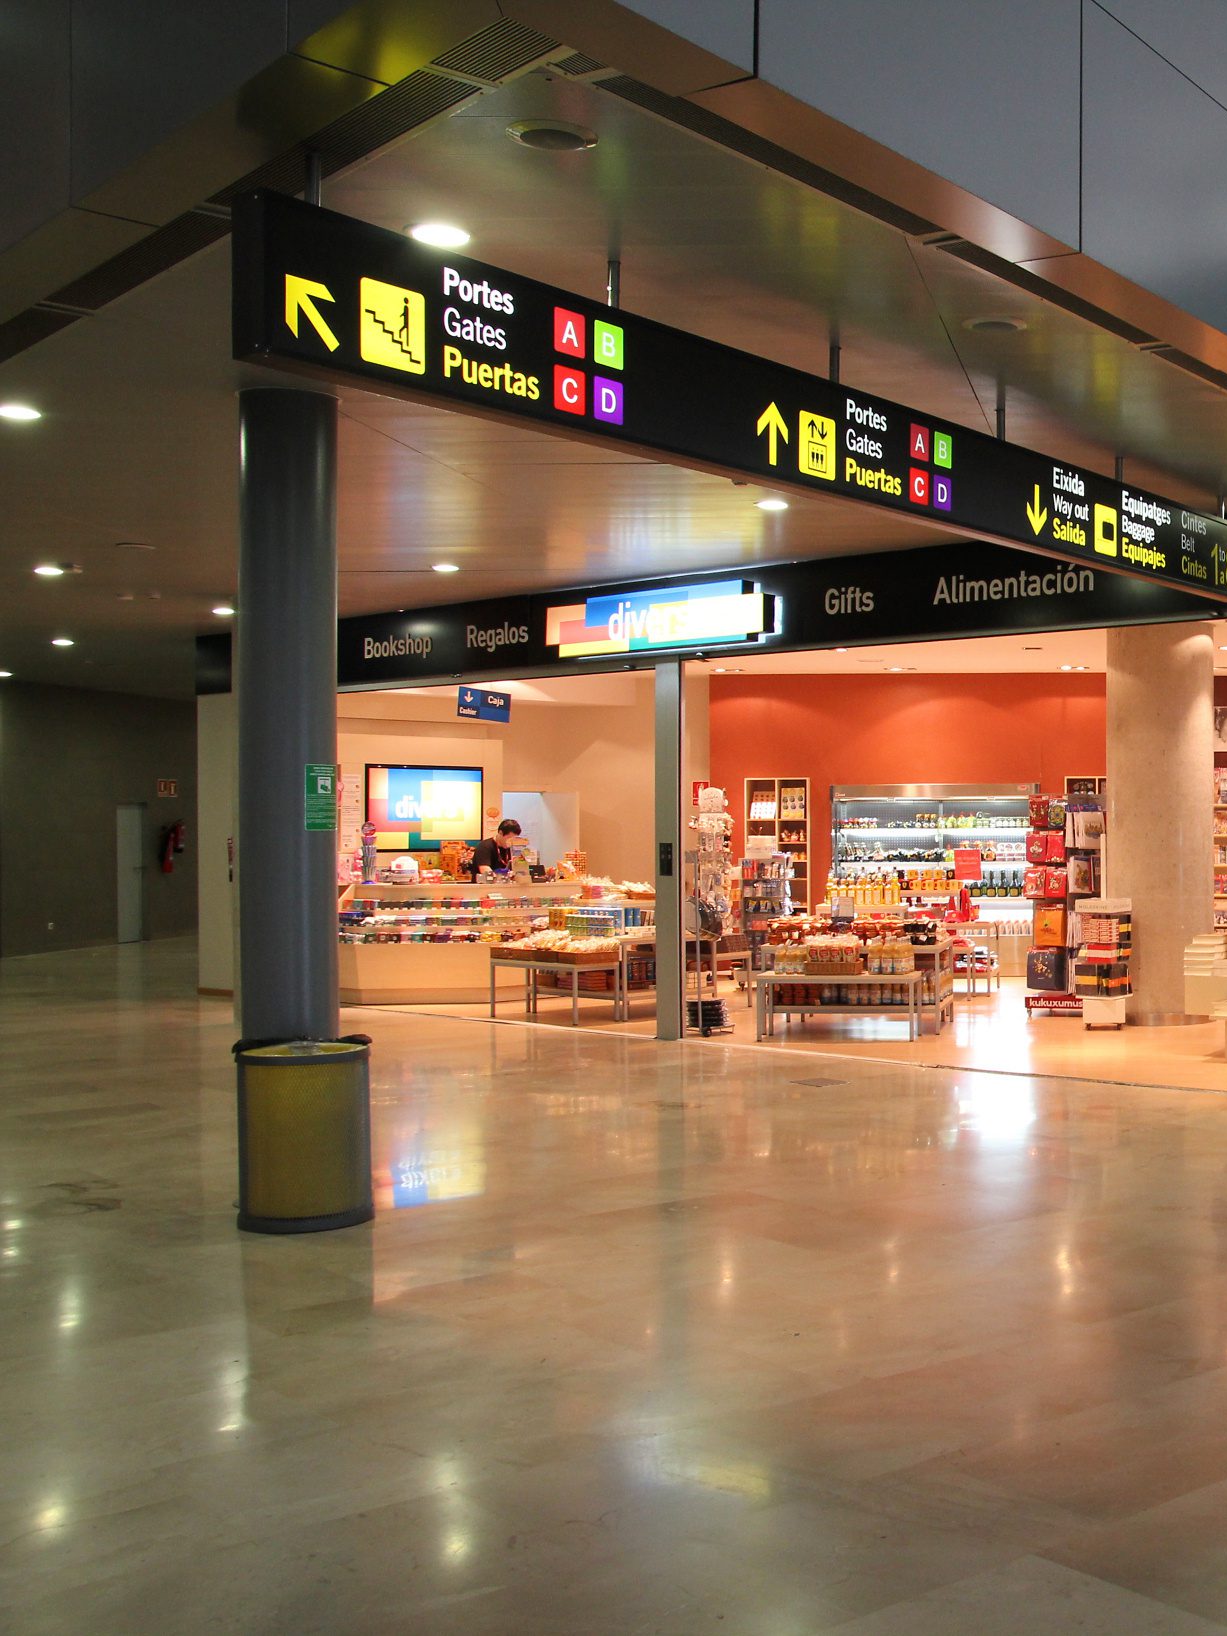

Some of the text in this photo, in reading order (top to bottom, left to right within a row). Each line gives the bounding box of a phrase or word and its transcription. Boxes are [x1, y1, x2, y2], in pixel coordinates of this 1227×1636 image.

[443, 266, 514, 315] Portes
[443, 306, 507, 350] Gates
[561, 320, 616, 358] A B
[443, 343, 540, 400] Puertas
[561, 376, 617, 415] C D
[846, 398, 888, 432] Portes
[845, 428, 883, 459] Gates
[914, 433, 948, 460] A B
[845, 456, 902, 496] Puertas
[914, 476, 948, 503] C D
[1053, 466, 1085, 497] Eixida
[1053, 493, 1089, 521] Way out
[1121, 490, 1171, 526] Equipatges
[1052, 517, 1086, 546] Salida
[1121, 514, 1155, 544] Baggage
[1181, 510, 1207, 536] Cintes
[1121, 536, 1166, 570] Equipajes
[1181, 533, 1195, 553] Belt
[1181, 555, 1207, 580] Cintas
[1210, 543, 1218, 585] 1
[933, 563, 1095, 606] Alimentación
[825, 586, 875, 616] Gifts
[363, 634, 432, 660] Bookshop
[466, 621, 529, 652] Regalos
[487, 695, 504, 707] Caja
